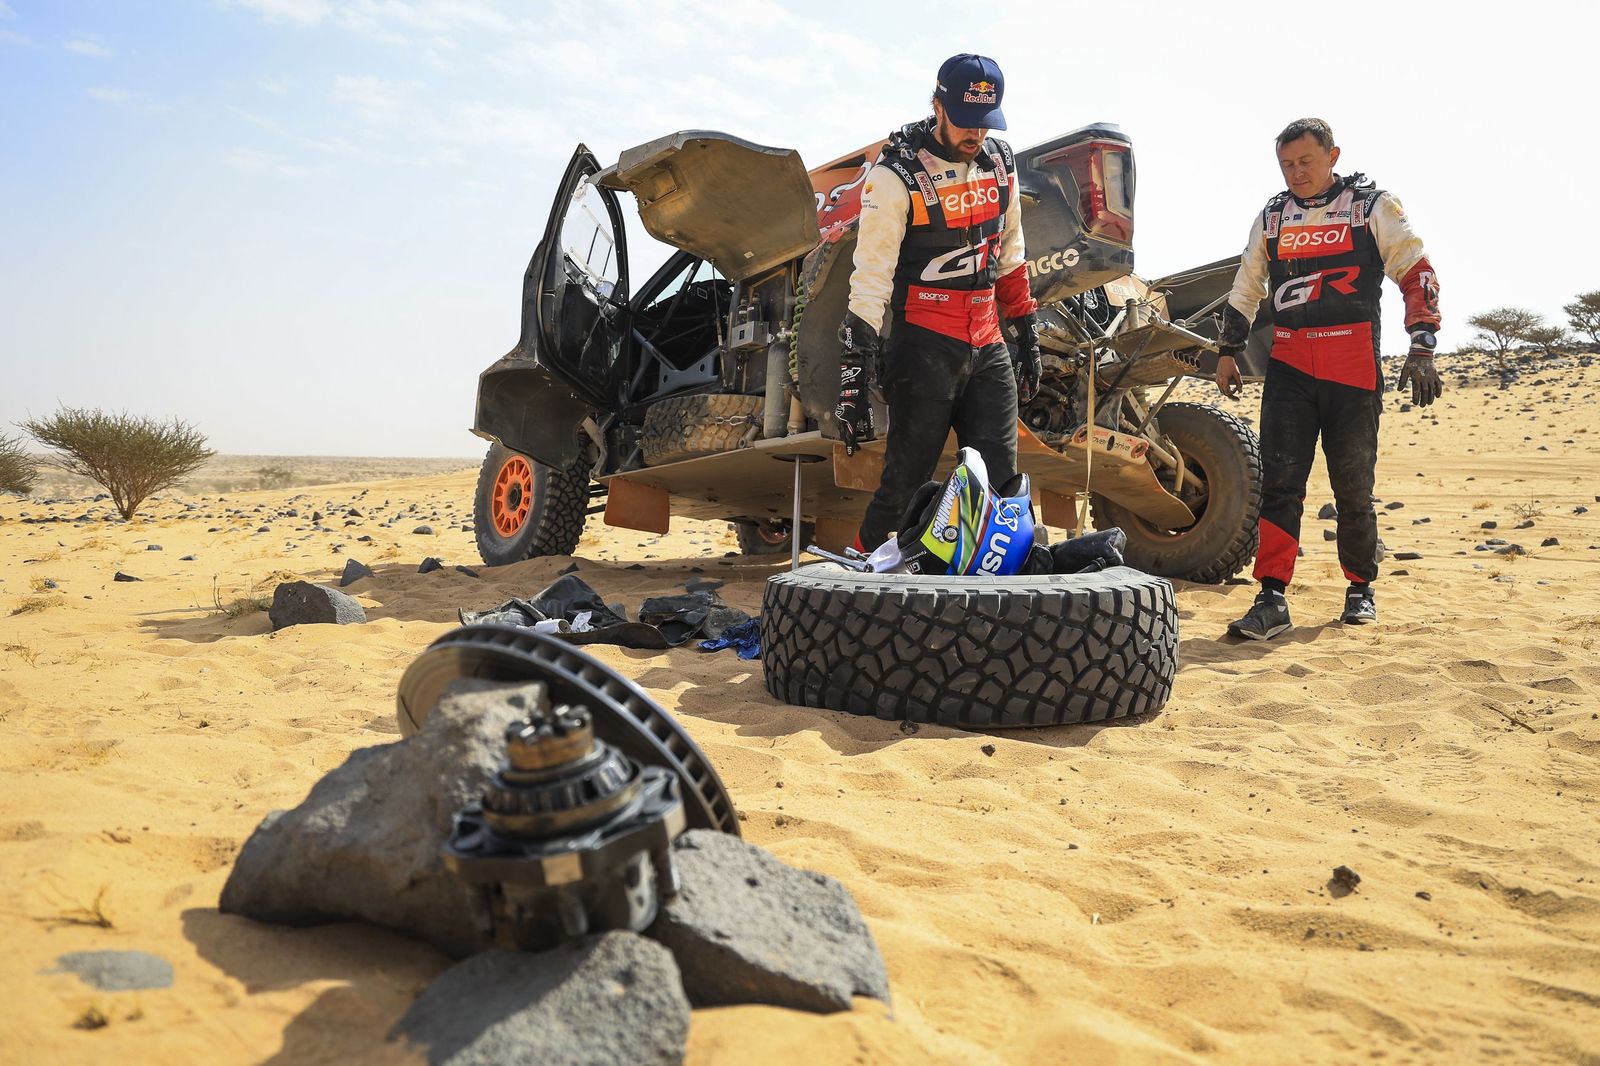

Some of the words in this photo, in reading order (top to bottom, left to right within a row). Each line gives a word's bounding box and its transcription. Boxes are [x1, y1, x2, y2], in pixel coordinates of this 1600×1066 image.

[964, 92, 982, 103] Red
[982, 94, 996, 104] Bull
[918, 174, 935, 201] SIMPSON
[939, 186, 1000, 214] epso
[1280, 226, 1348, 250] epsol
[918, 291, 950, 301] sparco
[1274, 266, 1360, 312] GR
